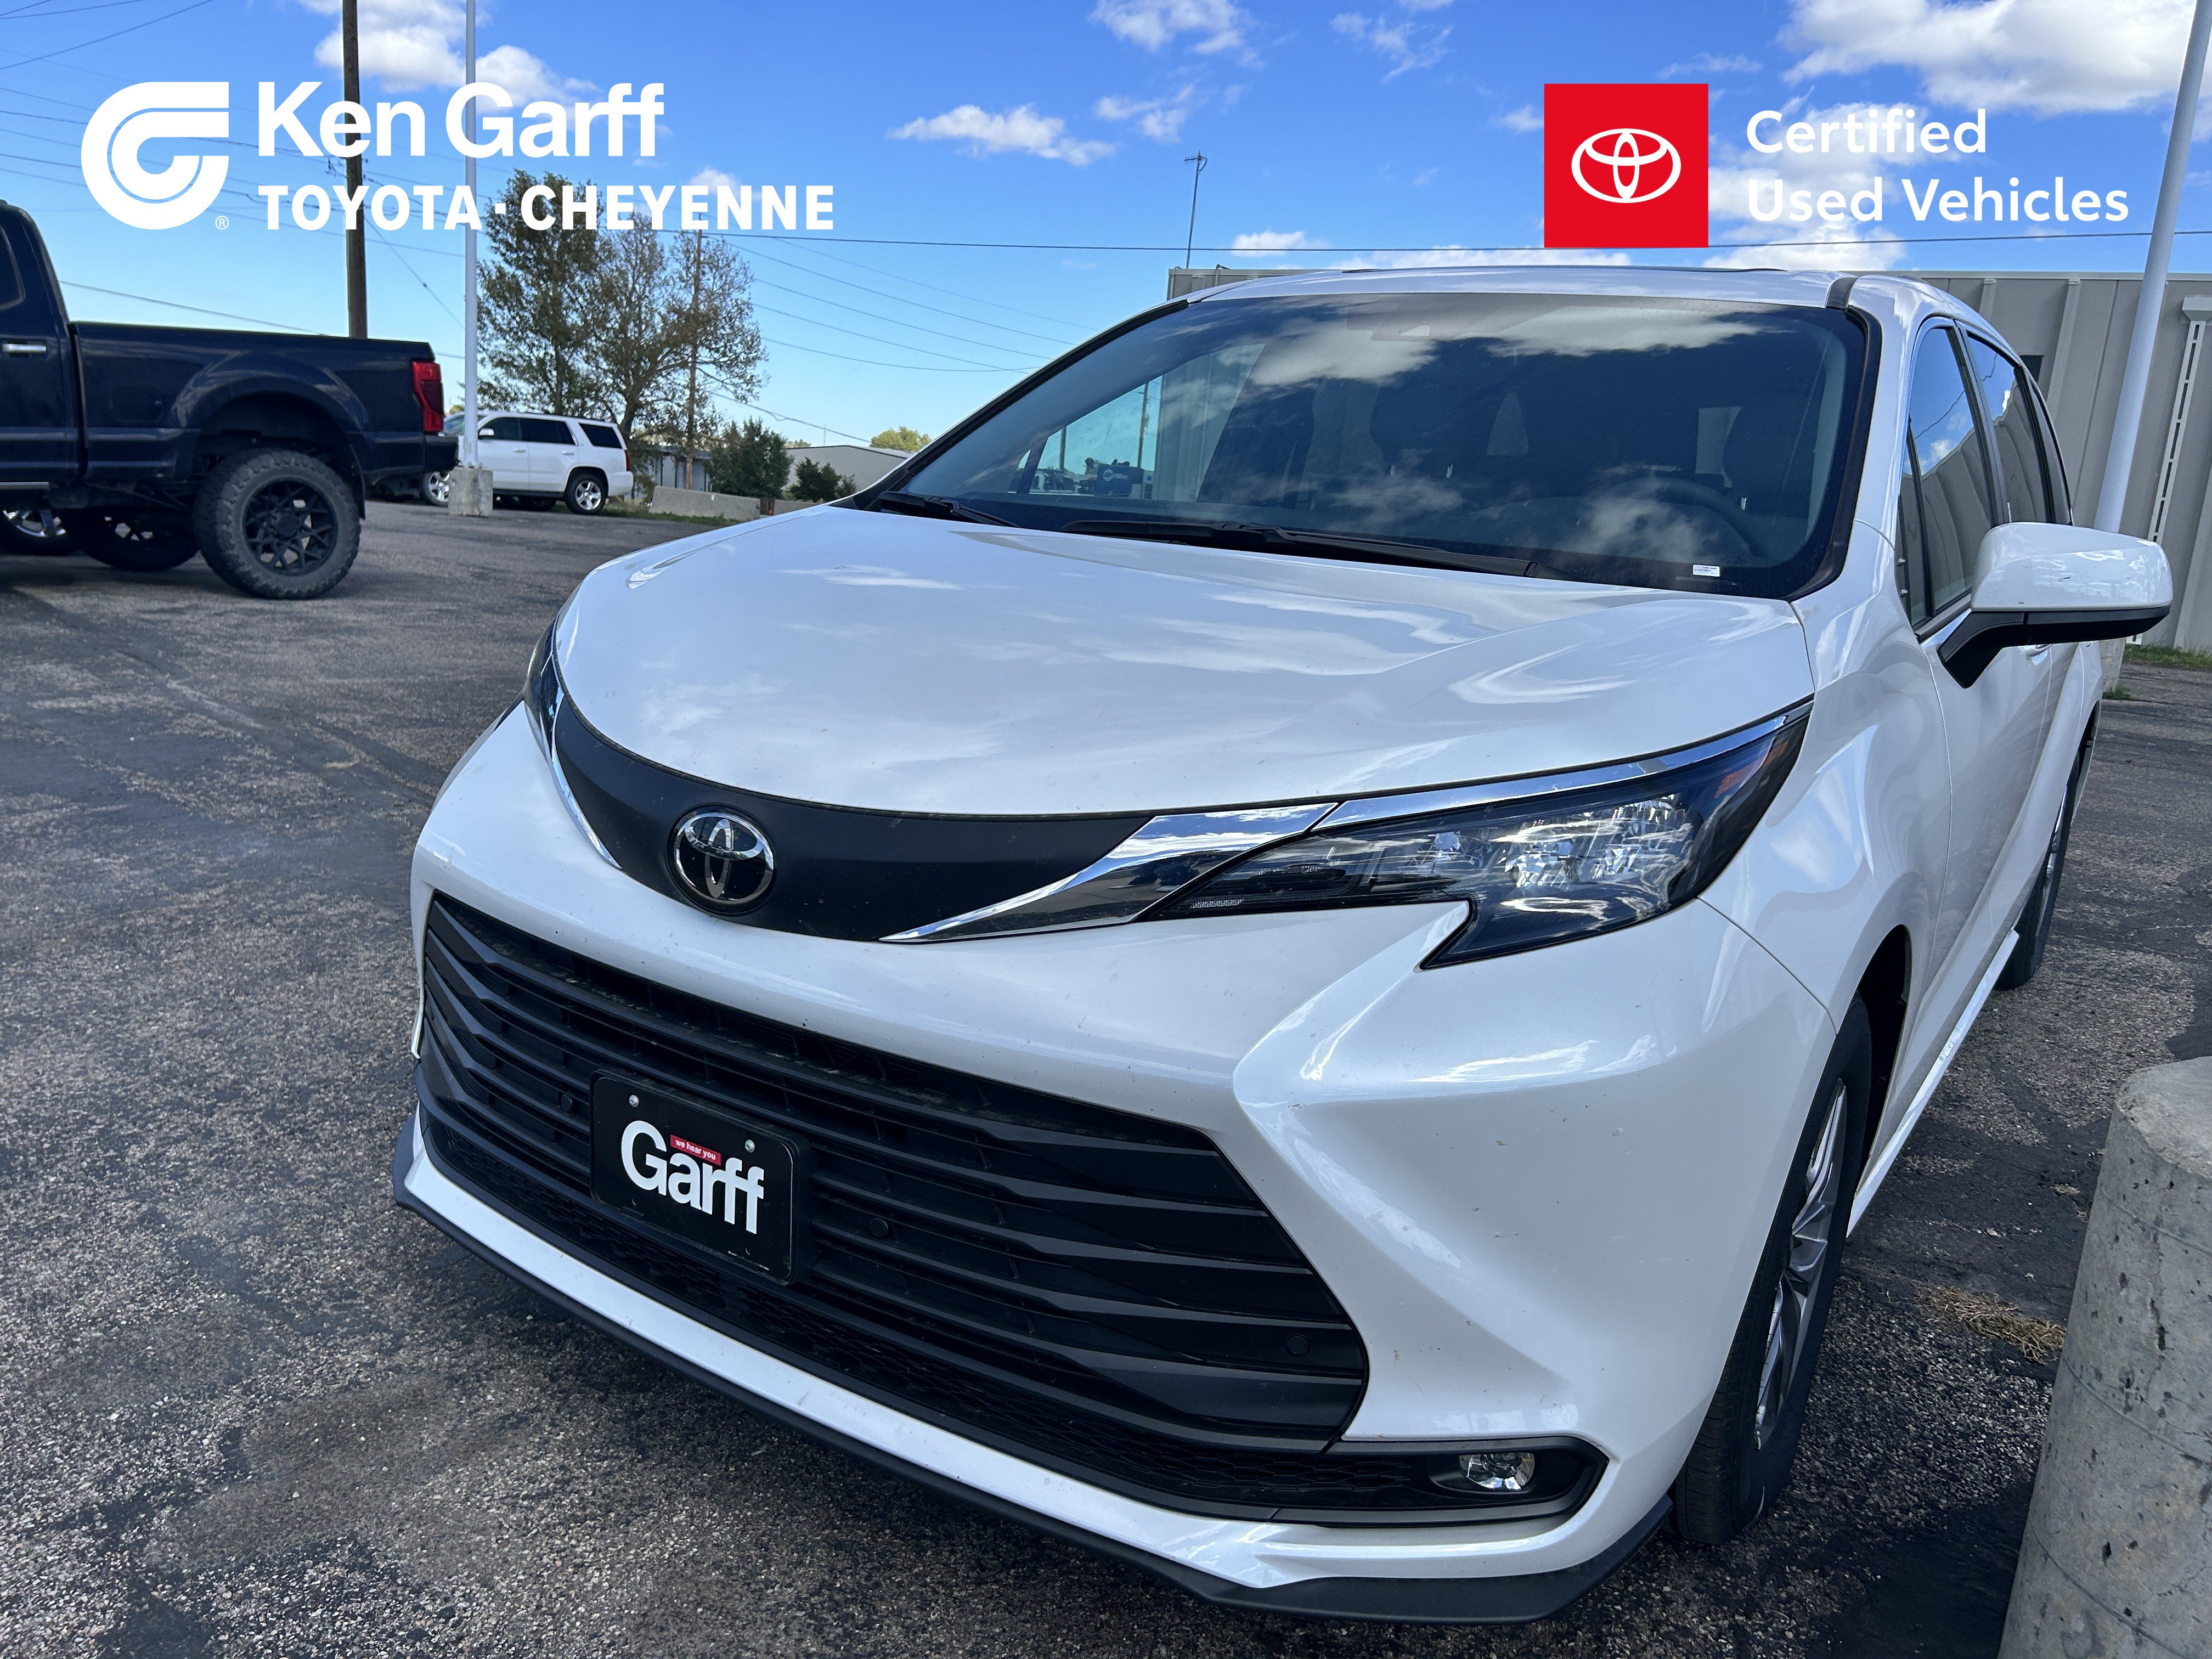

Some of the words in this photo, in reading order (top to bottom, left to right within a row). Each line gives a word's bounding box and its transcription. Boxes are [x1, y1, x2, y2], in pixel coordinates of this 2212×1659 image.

[621, 1120, 764, 1234] Garff
[675, 1139, 685, 1148] we
[686, 1142, 702, 1154] hear
[703, 1150, 716, 1160] you
